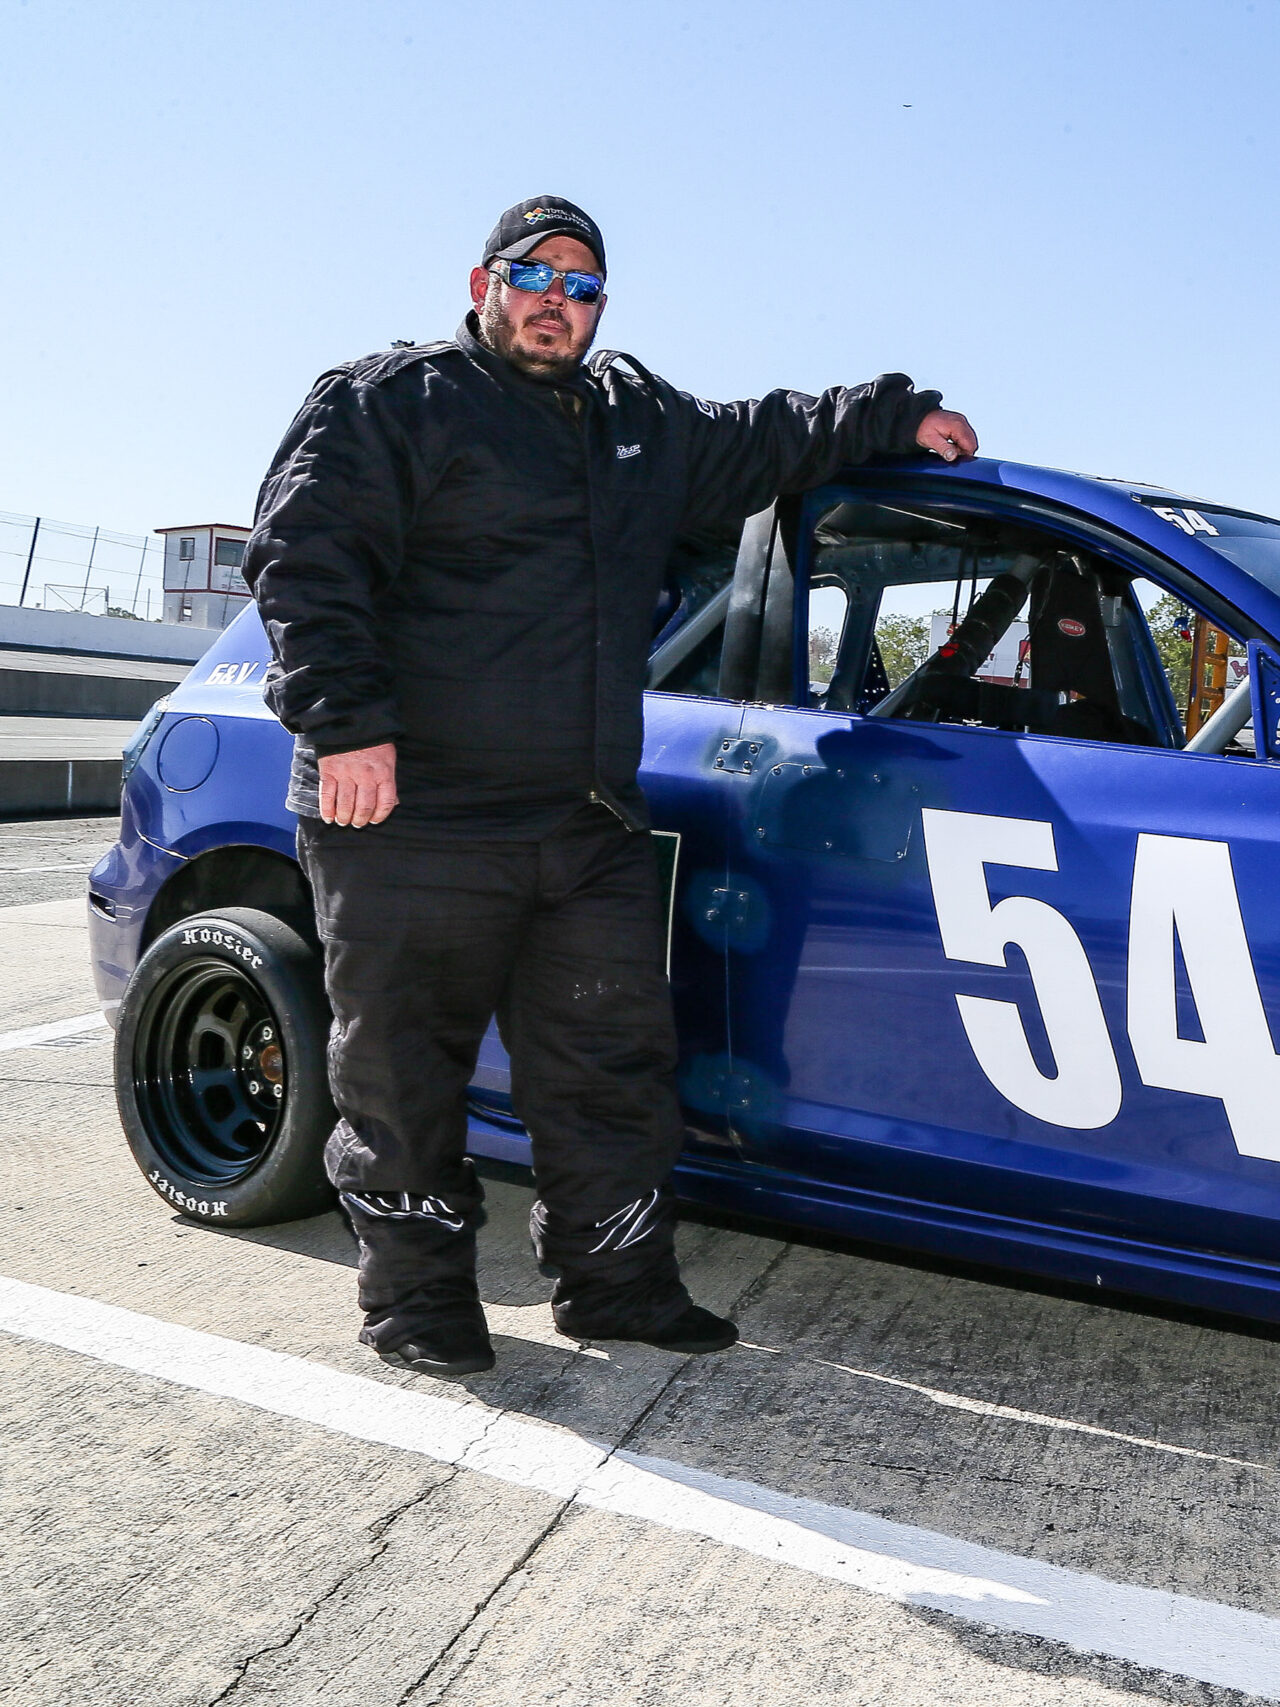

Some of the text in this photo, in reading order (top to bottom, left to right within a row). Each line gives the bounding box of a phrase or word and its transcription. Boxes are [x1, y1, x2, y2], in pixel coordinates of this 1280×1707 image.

[1150, 507, 1221, 536] 54
[180, 927, 264, 970] Hoosier
[148, 1169, 229, 1217] Hoosier
